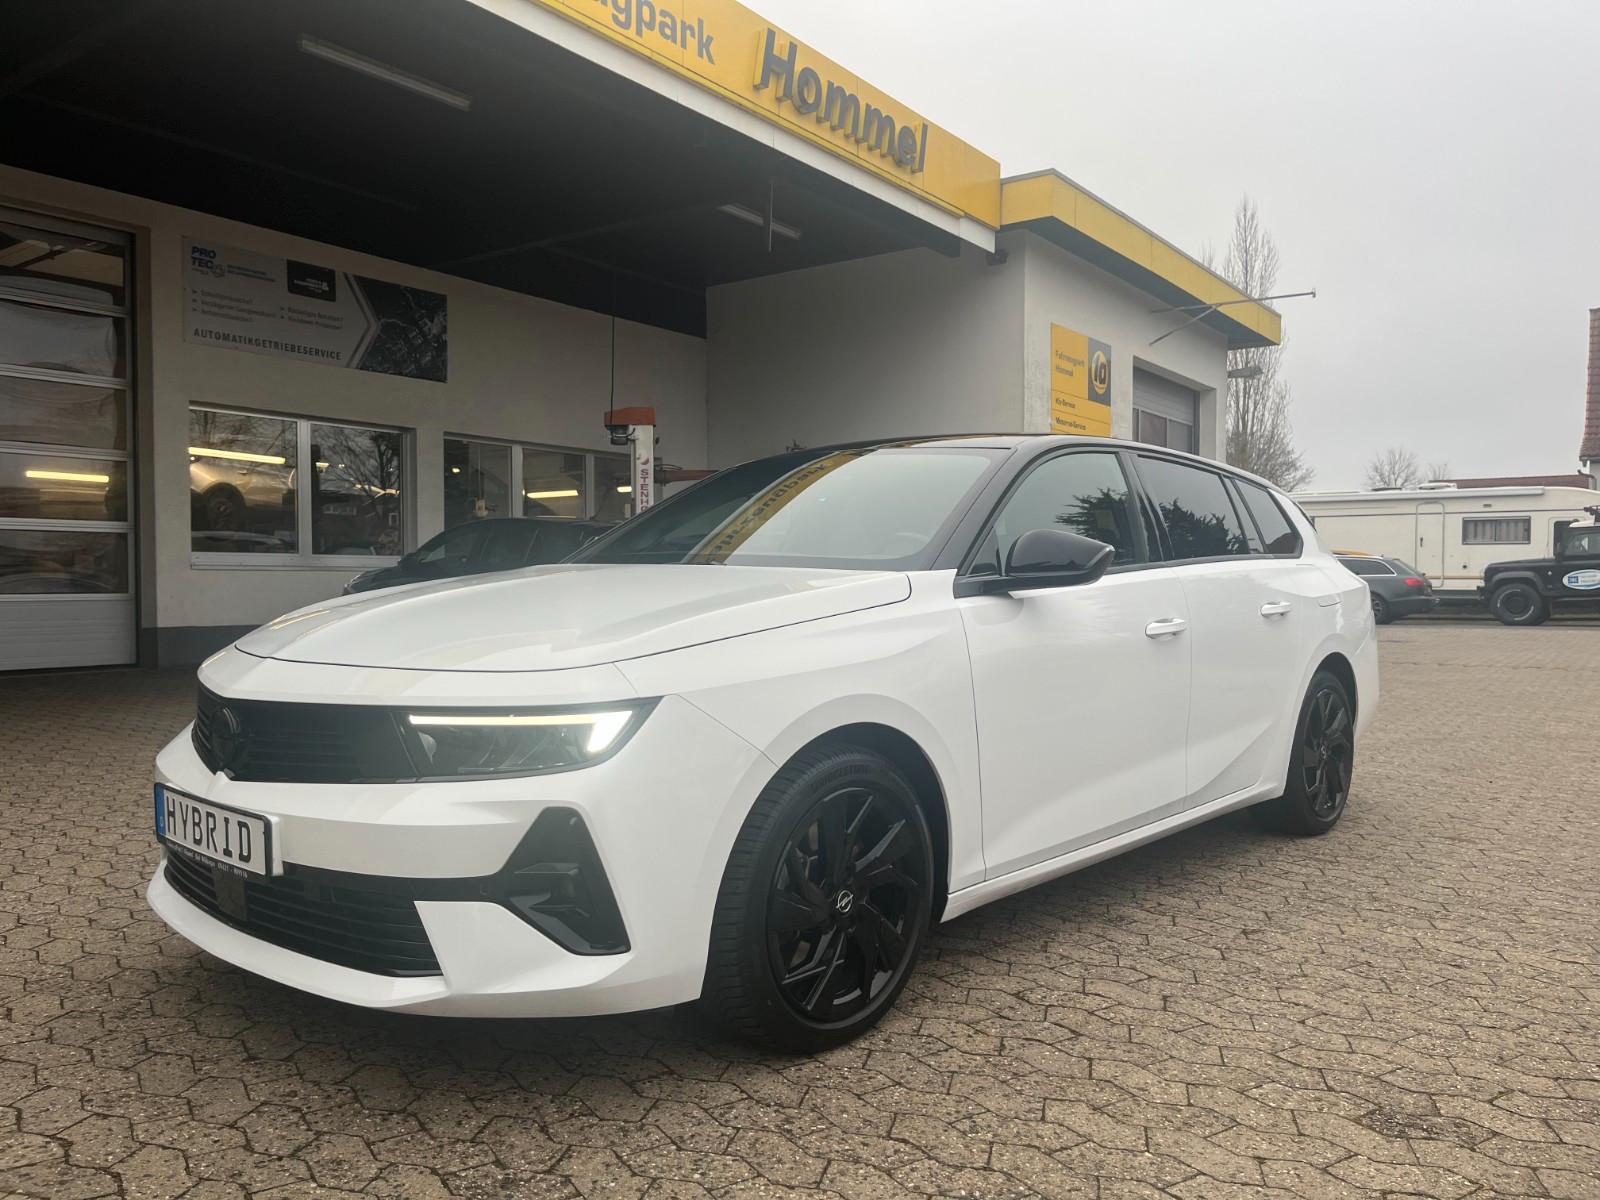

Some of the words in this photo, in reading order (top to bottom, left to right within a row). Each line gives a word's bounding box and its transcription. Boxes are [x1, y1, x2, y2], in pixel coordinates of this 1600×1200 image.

[593, 0, 715, 65] gpark
[759, 28, 928, 173] Hommel
[191, 245, 216, 259] PRO
[191, 257, 214, 269] TEC
[193, 328, 343, 361] AUTOMATIKGETRIEBESERVICE
[166, 795, 252, 863] HYBRID
